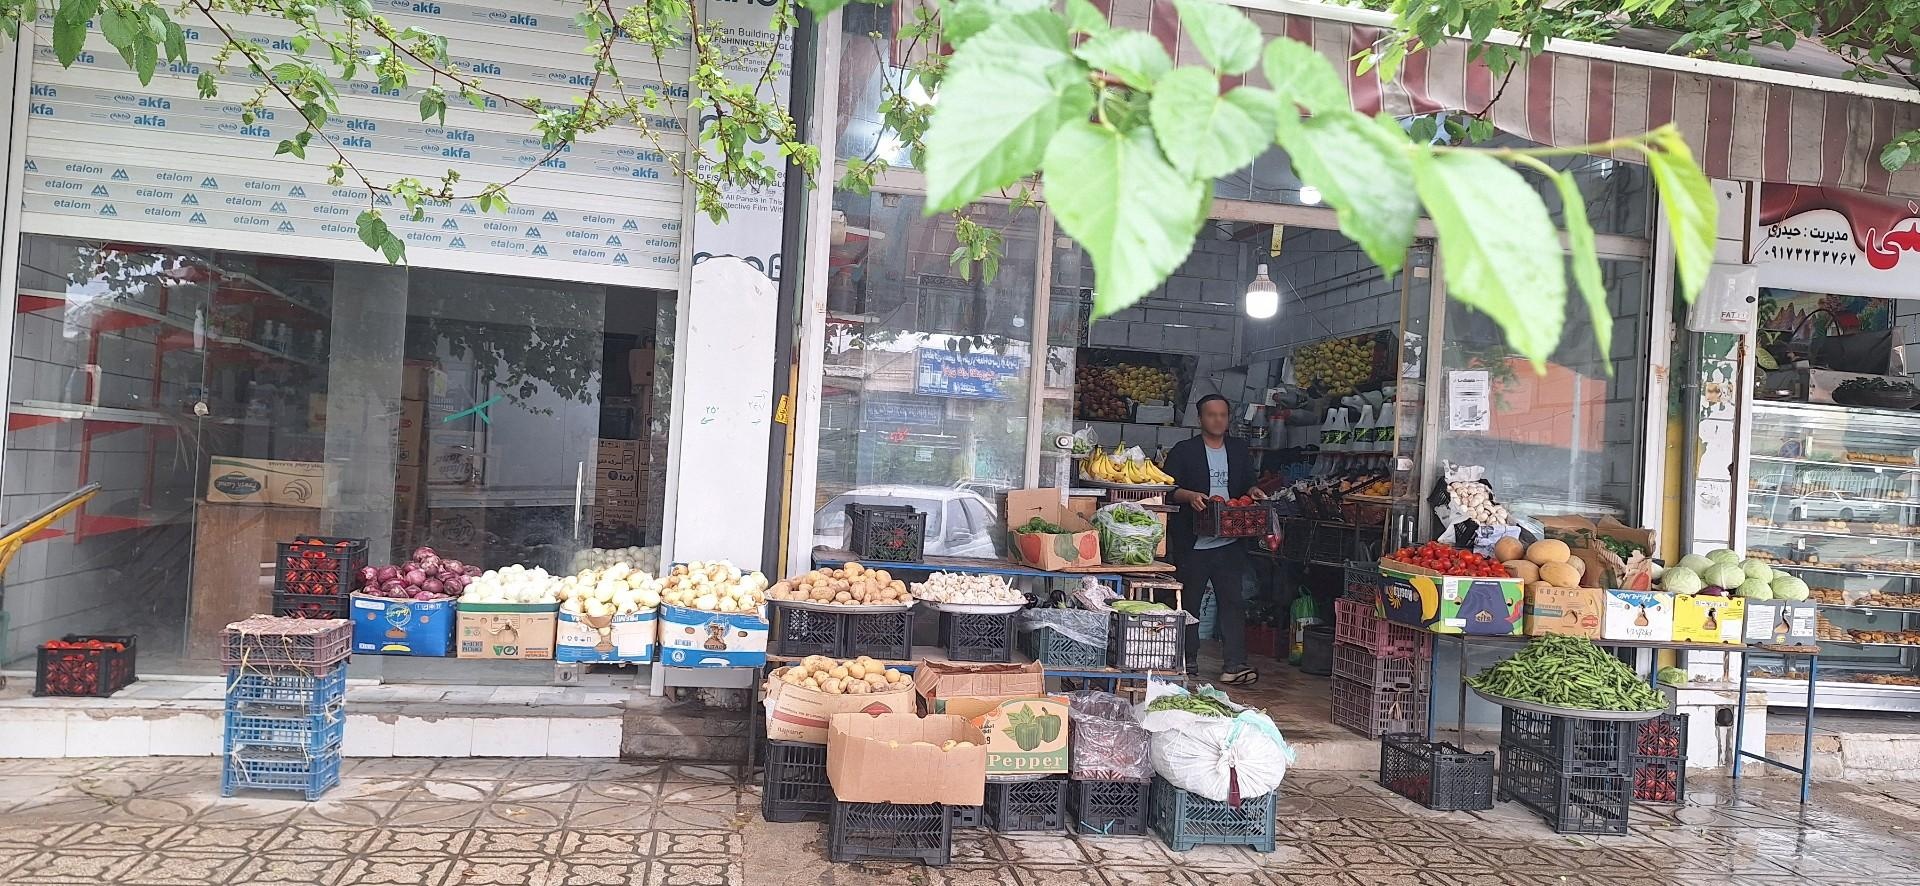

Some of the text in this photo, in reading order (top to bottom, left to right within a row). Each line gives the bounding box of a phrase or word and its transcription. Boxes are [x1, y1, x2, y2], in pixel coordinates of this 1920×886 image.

[412, 2, 441, 14] akfa
[510, 14, 538, 26] akfa
[738, 28, 776, 42] Building
[473, 63, 501, 75] akfa
[169, 62, 199, 75] akfa
[655, 117, 681, 129] akfa
[30, 103, 54, 116] kfa
[134, 115, 166, 127] akfa
[240, 125, 271, 138] akfa
[342, 136, 372, 149] akfa
[442, 147, 471, 159] akfa
[632, 168, 659, 179] akfa
[138, 97, 171, 109] akfa
[254, 108, 275, 120] kfa
[346, 119, 376, 131] akfa
[446, 130, 475, 142] akfa
[637, 151, 664, 163] akfa
[45, 180, 83, 190] etalom
[225, 197, 262, 207] etalom
[313, 205, 349, 216] etalom
[484, 222, 518, 232] etalom
[566, 230, 599, 240] etalom
[646, 239, 678, 249] etalom
[156, 172, 193, 183] etalom
[244, 181, 281, 192] etalom
[332, 189, 367, 200] etalom
[507, 206, 535, 216] talom
[582, 215, 616, 225] etalom
[662, 222, 681, 231] etal
[54, 199, 91, 210] etalom
[144, 207, 181, 218] etalom
[233, 216, 270, 226] etalom
[321, 223, 357, 234] etalom
[407, 232, 442, 242] etalom
[491, 240, 525, 250] etalom
[572, 249, 606, 259] etalom
[1768, 224, 1801, 239] حیدری
[1810, 227, 1848, 244] مدیریت
[988, 754, 1062, 770] Pepper
